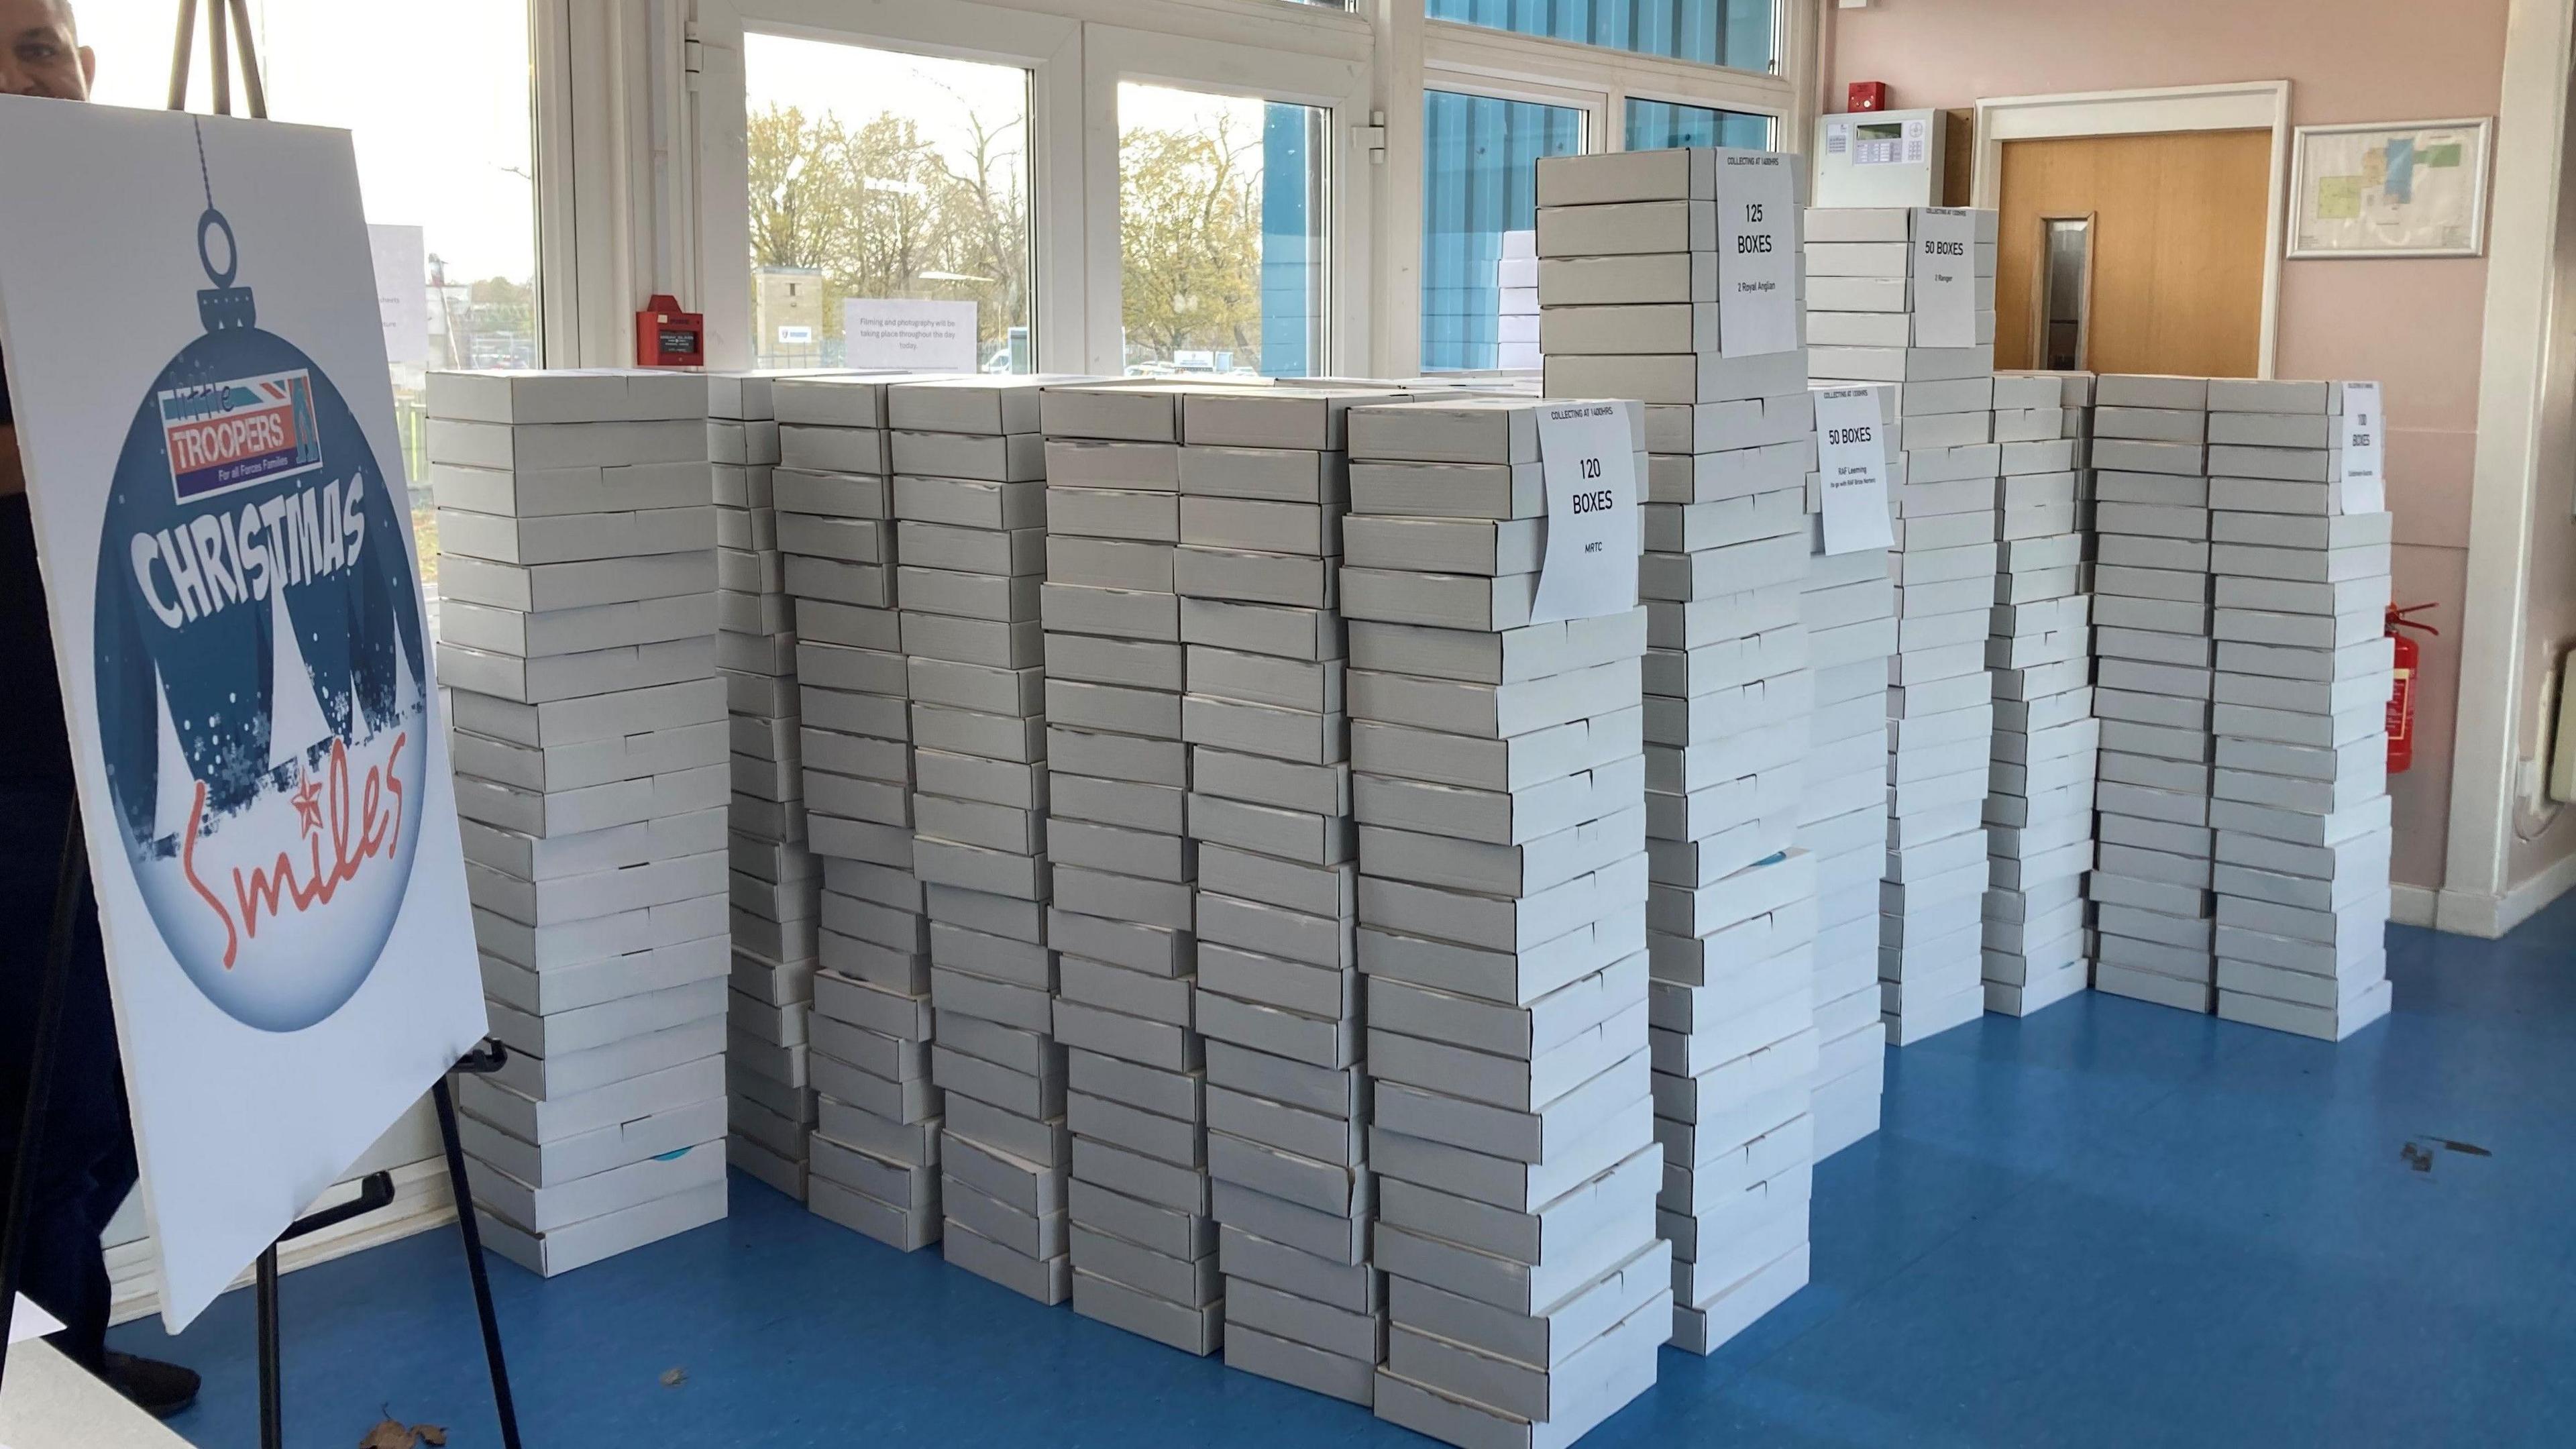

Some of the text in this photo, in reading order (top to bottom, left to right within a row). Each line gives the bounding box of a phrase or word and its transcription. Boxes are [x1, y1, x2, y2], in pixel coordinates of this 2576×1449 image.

[1727, 156, 1754, 166] COLLECTING
[1746, 204, 1763, 223] 125
[1737, 235, 1772, 254] BOXES
[1925, 241, 1964, 256] 50 BOXES
[1737, 280, 1776, 293] 2 Royal Anglian
[860, 317, 883, 327] Filming
[897, 319, 934, 327] photography
[860, 330, 880, 338] taking
[881, 330, 898, 338] place
[899, 330, 932, 339] throughout
[944, 331, 955, 339] day
[171, 366, 234, 421] little
[1551, 409, 1583, 421] COLLECTING
[1584, 408, 1590, 417] AT
[172, 413, 284, 469] TROOPERS
[1829, 427, 1872, 445] 50 BOXES
[218, 457, 288, 482] For all Forces Families
[1580, 458, 1601, 480] 120
[1838, 467, 1847, 475] RAF
[1572, 490, 1613, 515] BOXES
[131, 472, 364, 629] CHRISTMAS
[1585, 541, 1603, 553] MRTC
[184, 731, 406, 970] Smiles
